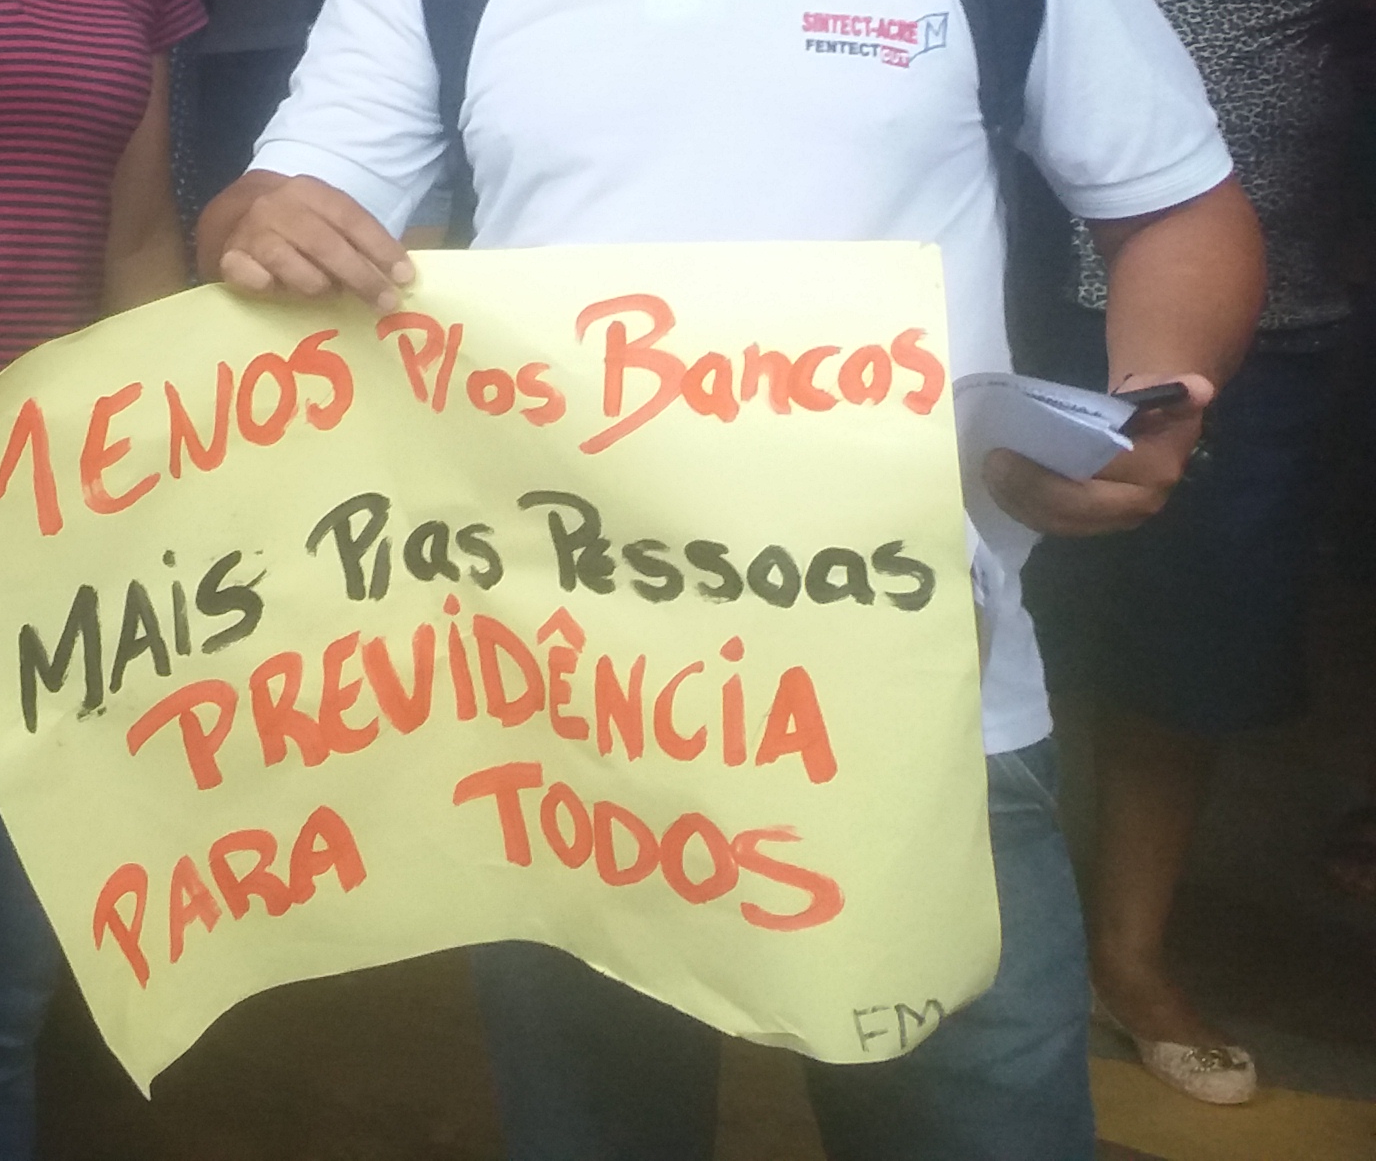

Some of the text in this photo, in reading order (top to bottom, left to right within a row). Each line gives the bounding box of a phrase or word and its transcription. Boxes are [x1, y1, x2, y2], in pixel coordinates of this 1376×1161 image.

[805, 39, 880, 57] FENTECT
[94, 762, 846, 988] PARA TODOS
